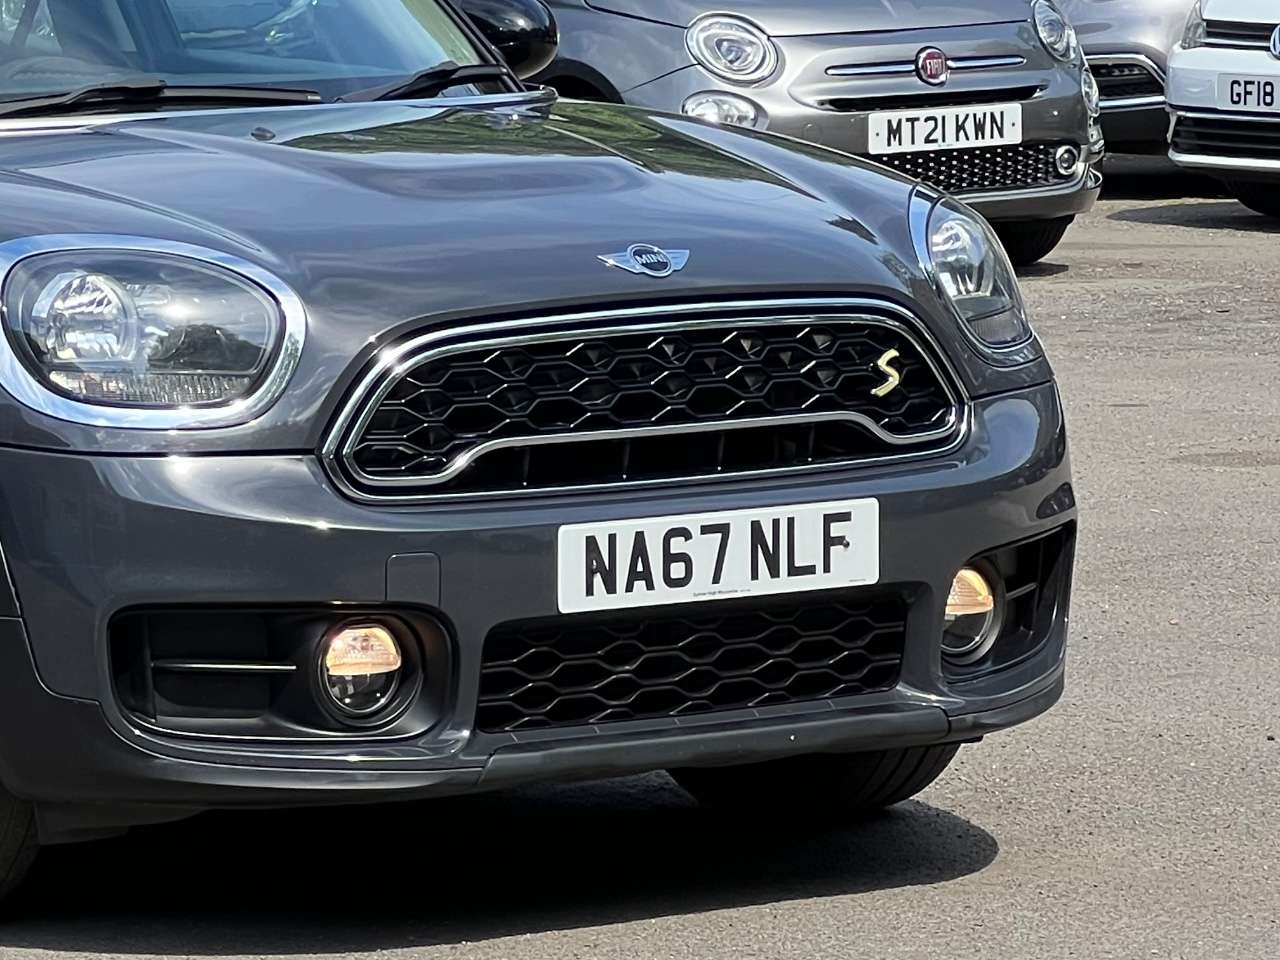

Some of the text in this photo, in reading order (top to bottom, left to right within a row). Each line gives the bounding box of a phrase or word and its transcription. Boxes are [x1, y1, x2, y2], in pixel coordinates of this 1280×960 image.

[1230, 79, 1275, 107] GF18
[886, 110, 1005, 147] MT21 KWN
[635, 253, 668, 265] MINI
[584, 510, 853, 598] NA67 NLF
